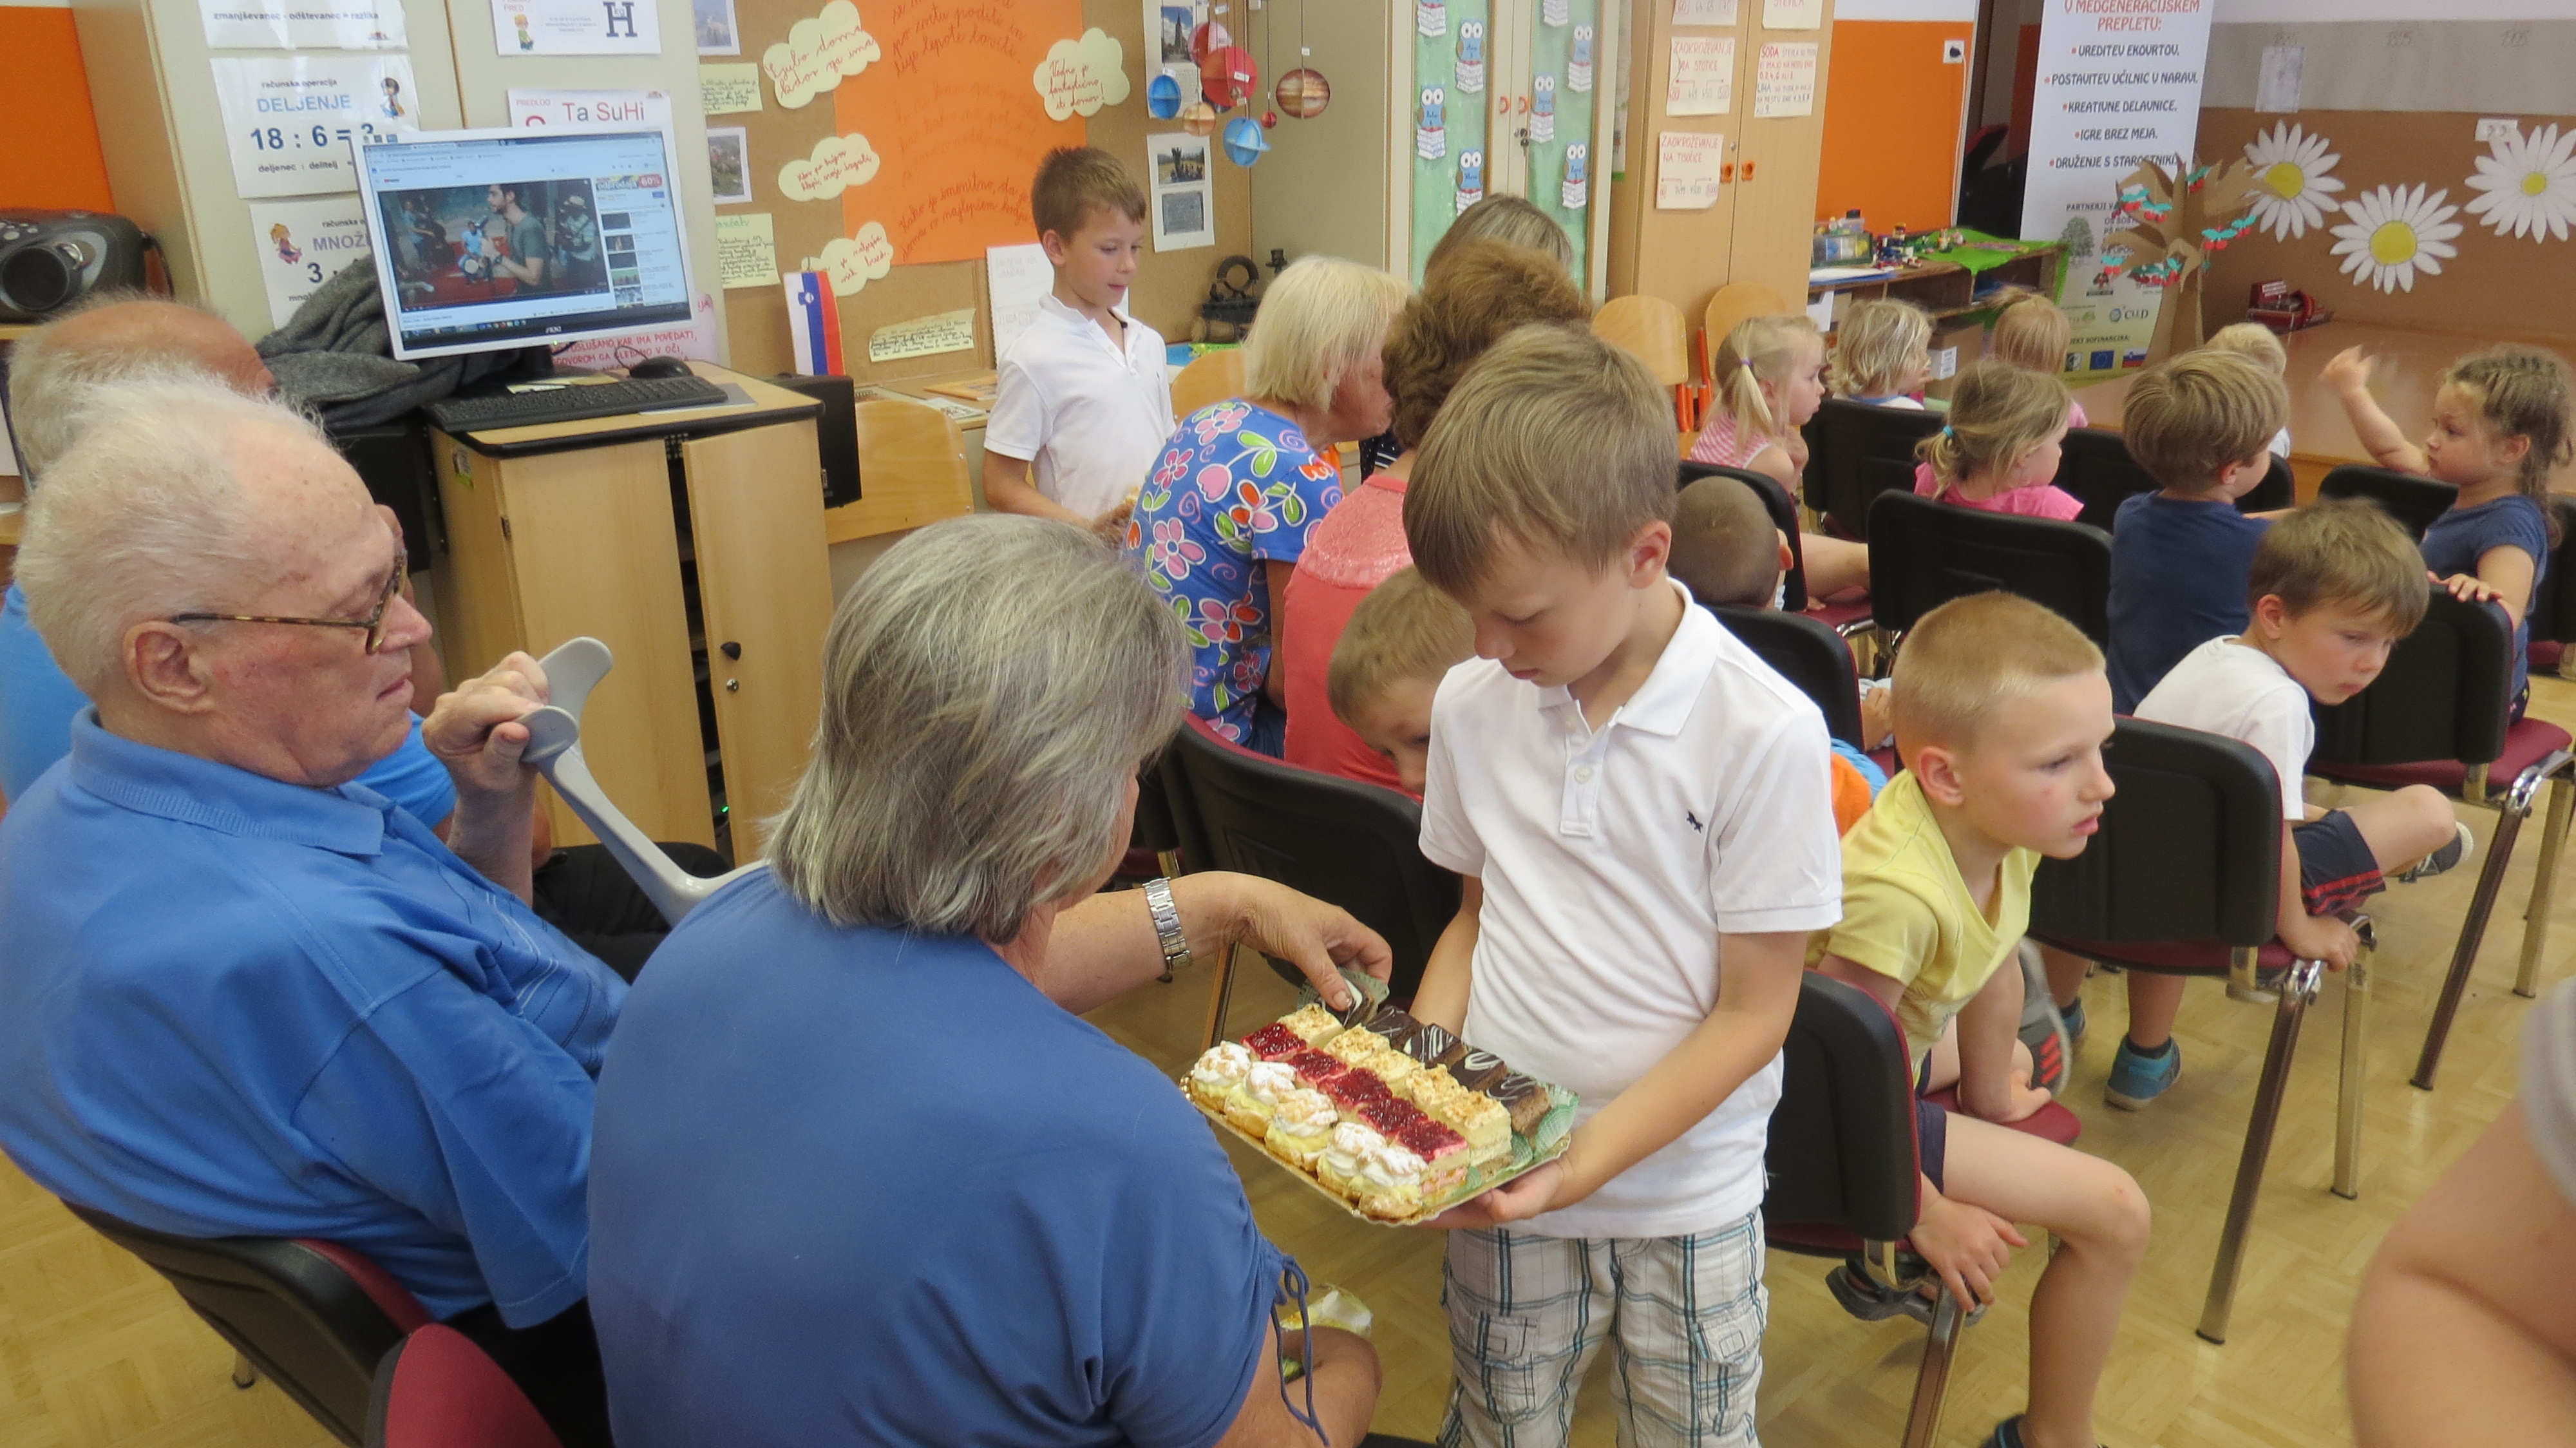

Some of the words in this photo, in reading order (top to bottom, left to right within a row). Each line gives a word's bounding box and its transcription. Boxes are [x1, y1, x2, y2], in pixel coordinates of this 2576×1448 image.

[2075, 0, 2200, 14] MEDGENERACIJSKEM
[213, 12, 281, 21] zmanjševanec
[289, 12, 340, 21] odštevanec
[603, 1, 638, 37] H
[2098, 17, 2163, 31] PREPLETU:
[1761, 46, 1779, 59] SODA
[2078, 44, 2125, 57] UREDITEV
[2126, 44, 2180, 56] EKOVRTOV.
[302, 79, 337, 88] operacija
[2052, 72, 2110, 86] POSTAVITEV
[2112, 69, 2149, 84] UČILNIC
[2161, 71, 2198, 84] NARAVI.
[258, 95, 352, 112] DELJENJE
[2068, 101, 2120, 113] KREATIVNE
[2122, 99, 2177, 112] DELAVNICE.
[562, 102, 589, 122] Ta
[596, 102, 644, 122] SuHi
[251, 128, 284, 150] 18
[312, 125, 328, 147] 6
[2080, 129, 2102, 140] IGRE
[2104, 128, 2128, 140] BREZ
[2130, 128, 2158, 139] MEJA.
[258, 164, 297, 173] deljenec
[309, 161, 338, 170] delitelj
[2055, 155, 2101, 169] DRUŽENJE
[2105, 157, 2110, 167] S
[2066, 203, 2107, 212] PARTNERJI
[307, 262, 322, 283] 3
